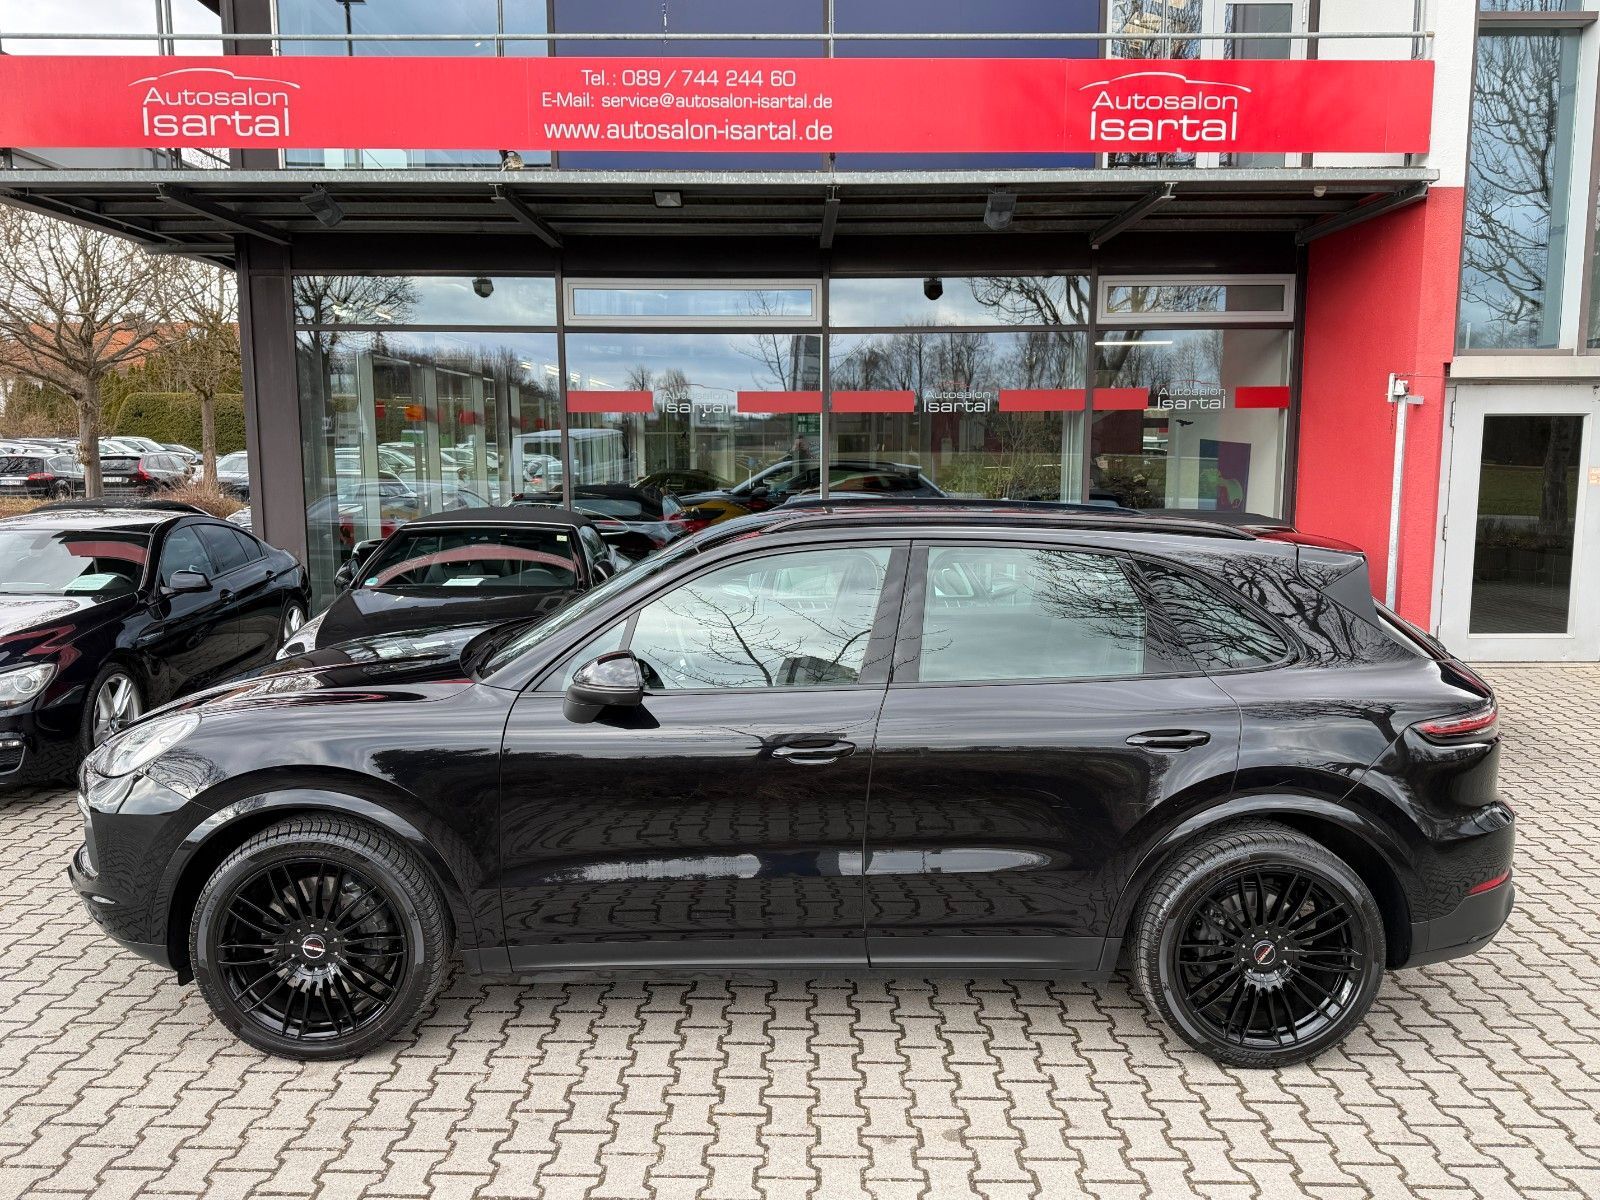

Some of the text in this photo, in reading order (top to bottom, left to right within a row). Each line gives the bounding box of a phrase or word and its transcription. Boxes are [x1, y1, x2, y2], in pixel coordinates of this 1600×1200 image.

[581, 69, 616, 86] Tel.:
[622, 69, 661, 86] 089
[682, 69, 719, 87] 744
[725, 69, 764, 87] 244
[770, 69, 797, 87] 60
[143, 87, 289, 106] Autosalon
[542, 91, 833, 109] E-Mail: service@autosalon-isartal.de
[1092, 90, 1239, 110] Autosalon
[142, 106, 290, 137] Isartal
[543, 118, 833, 141] www.autosalon-isartal.de
[1090, 110, 1238, 141] Isartal
[924, 390, 991, 399] Autosalon
[1158, 387, 1226, 396] Autosalon
[662, 398, 729, 413] Isartal
[923, 399, 991, 413] Isartal
[1157, 396, 1226, 410] Isartal
